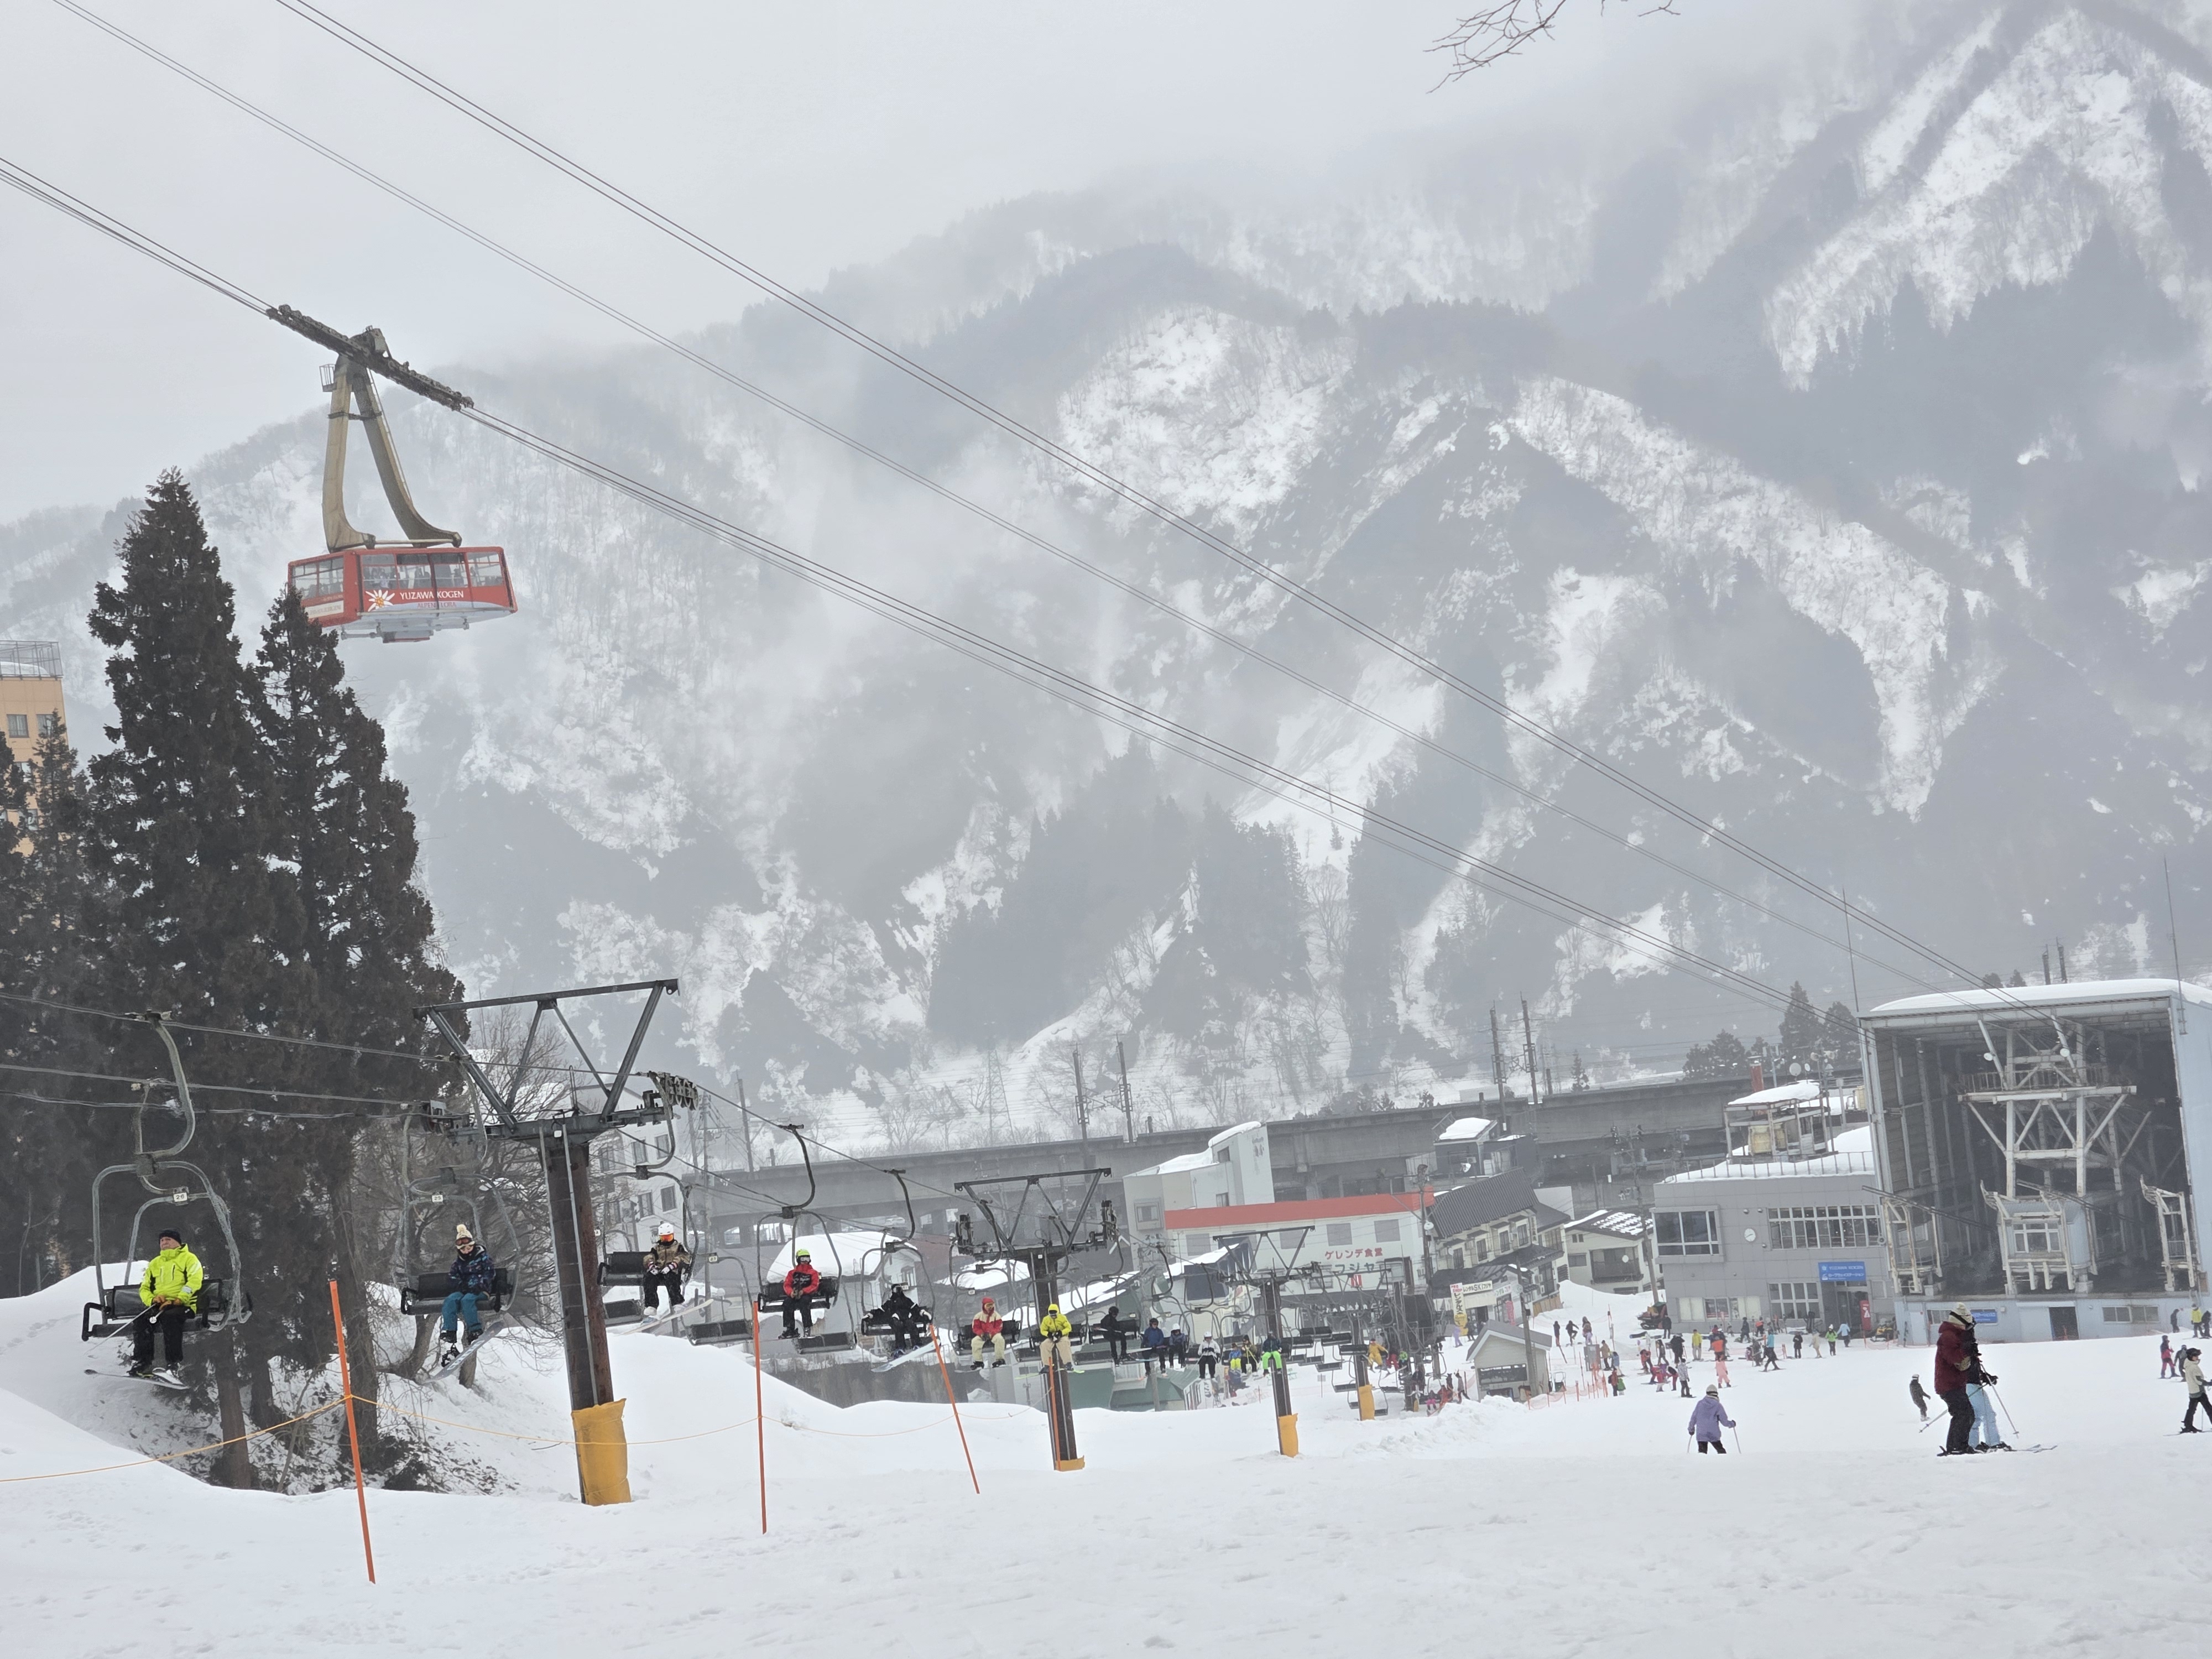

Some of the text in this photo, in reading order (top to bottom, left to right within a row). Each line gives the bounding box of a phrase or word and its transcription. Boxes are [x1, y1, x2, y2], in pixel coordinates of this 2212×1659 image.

[400, 591, 434, 600] YUZAWA
[1325, 1248, 1383, 1260] ゲレンデ食堂
